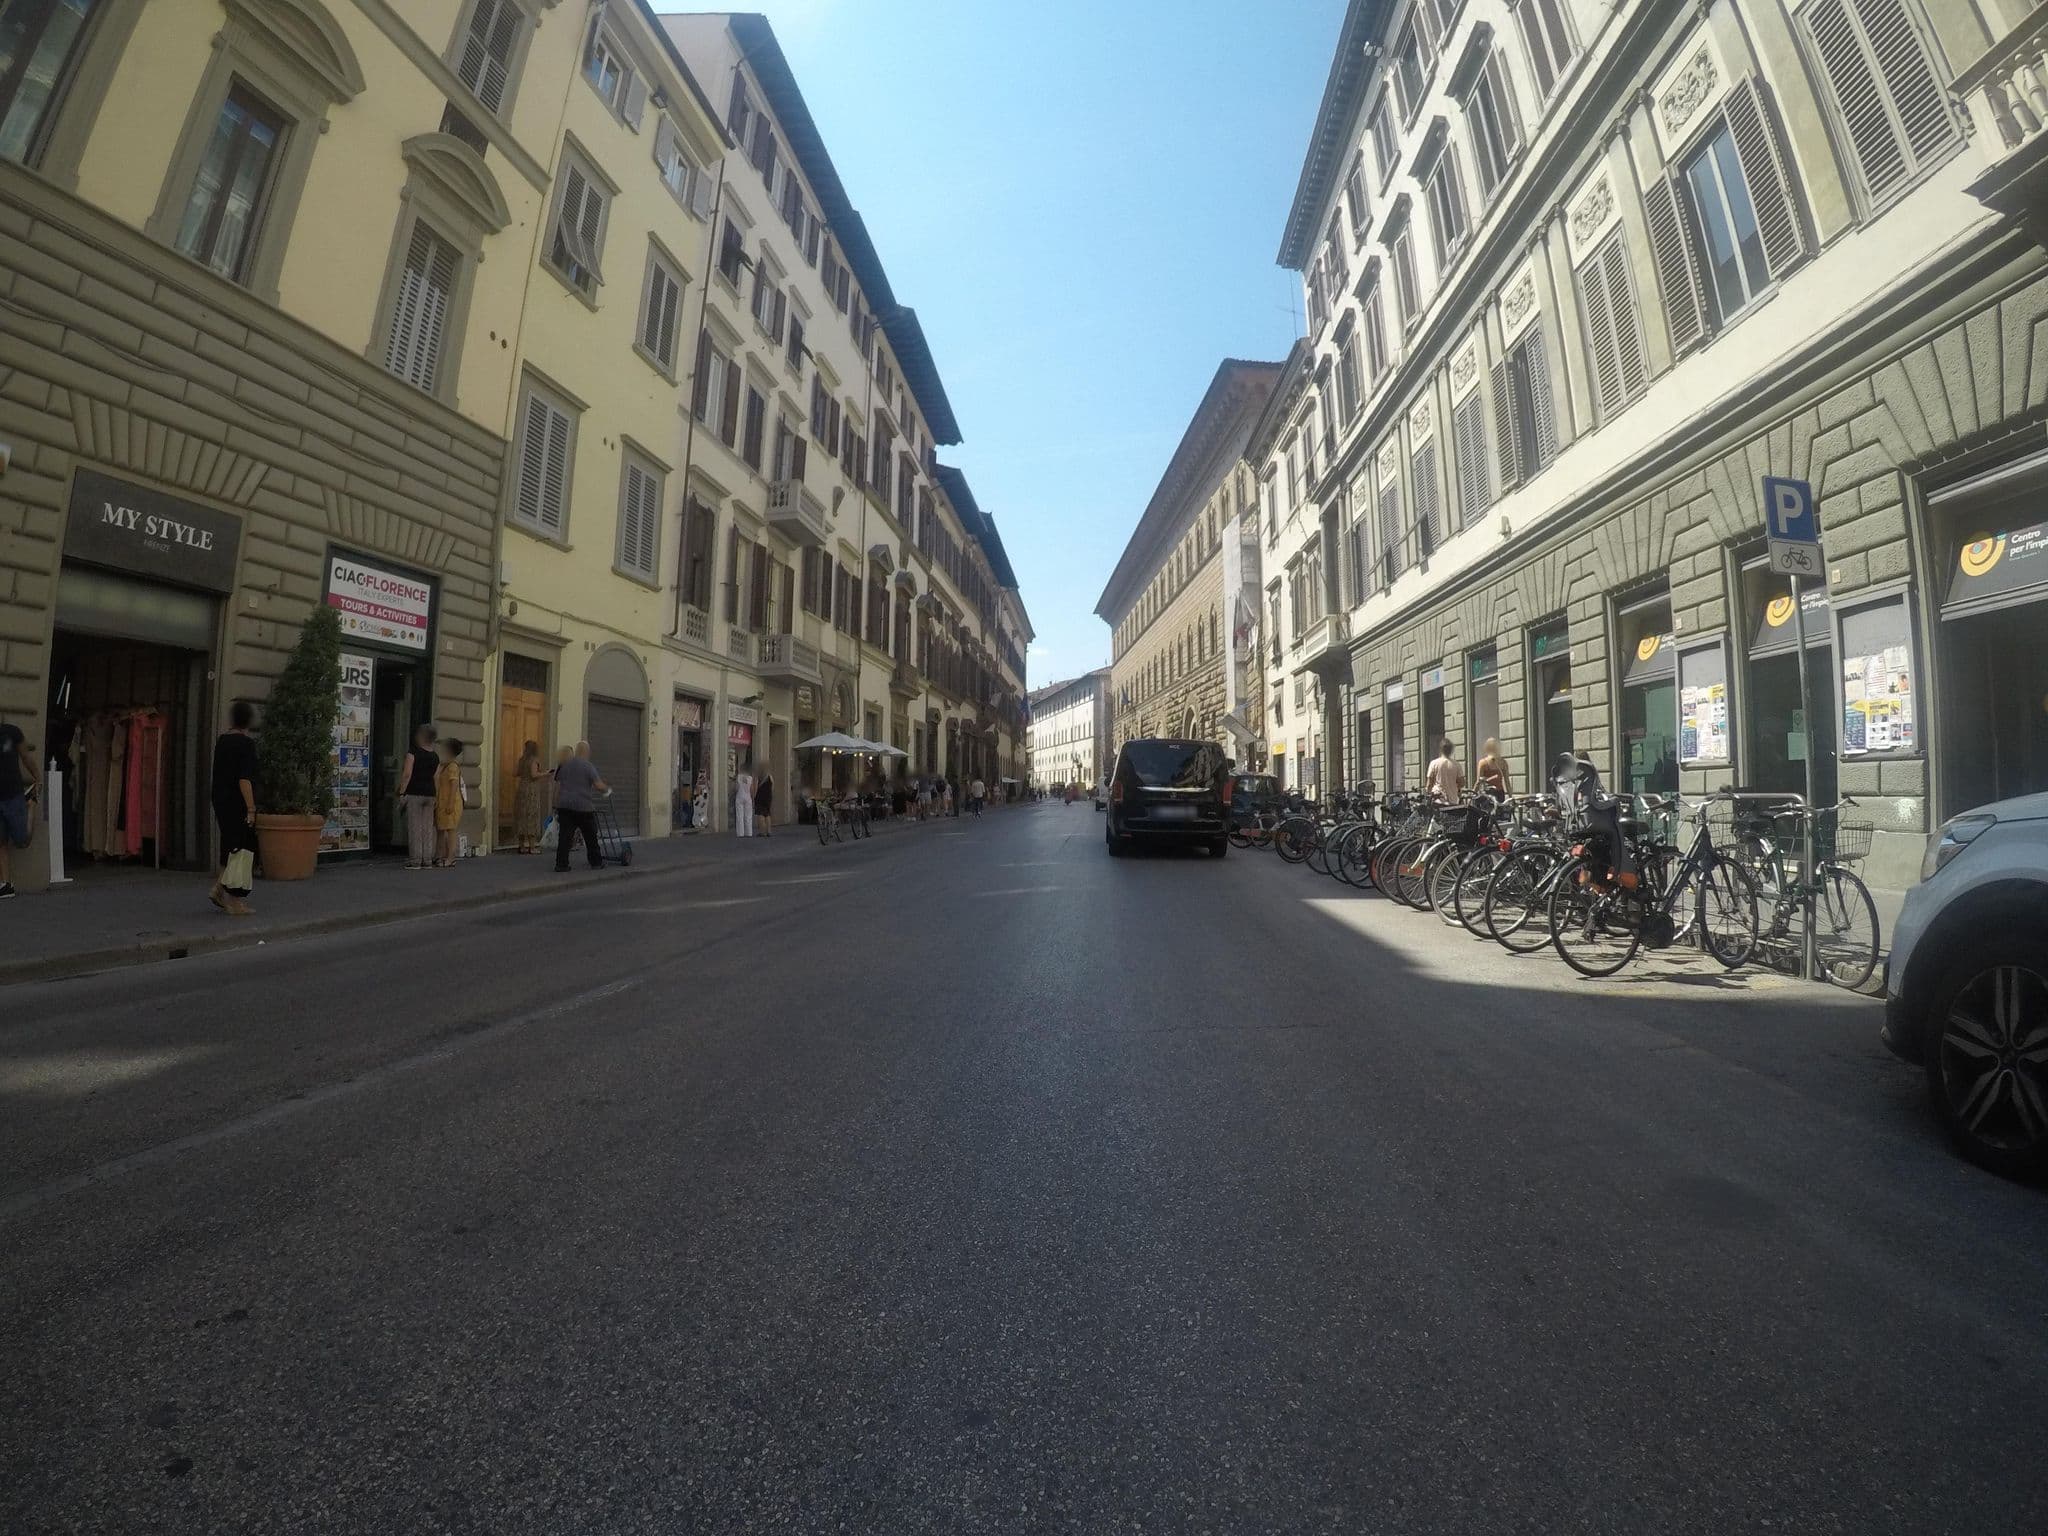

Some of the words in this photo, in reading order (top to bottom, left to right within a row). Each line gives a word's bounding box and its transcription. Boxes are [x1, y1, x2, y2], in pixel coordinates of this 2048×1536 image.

[1774, 484, 1804, 533] P
[101, 502, 142, 531] MY
[145, 515, 213, 551] STYLE
[2011, 530, 2041, 544] Centro
[2009, 544, 2025, 557] per
[341, 598, 368, 614] TOURS
[369, 605, 375, 615] &
[376, 607, 417, 625] ACTIVITIES
